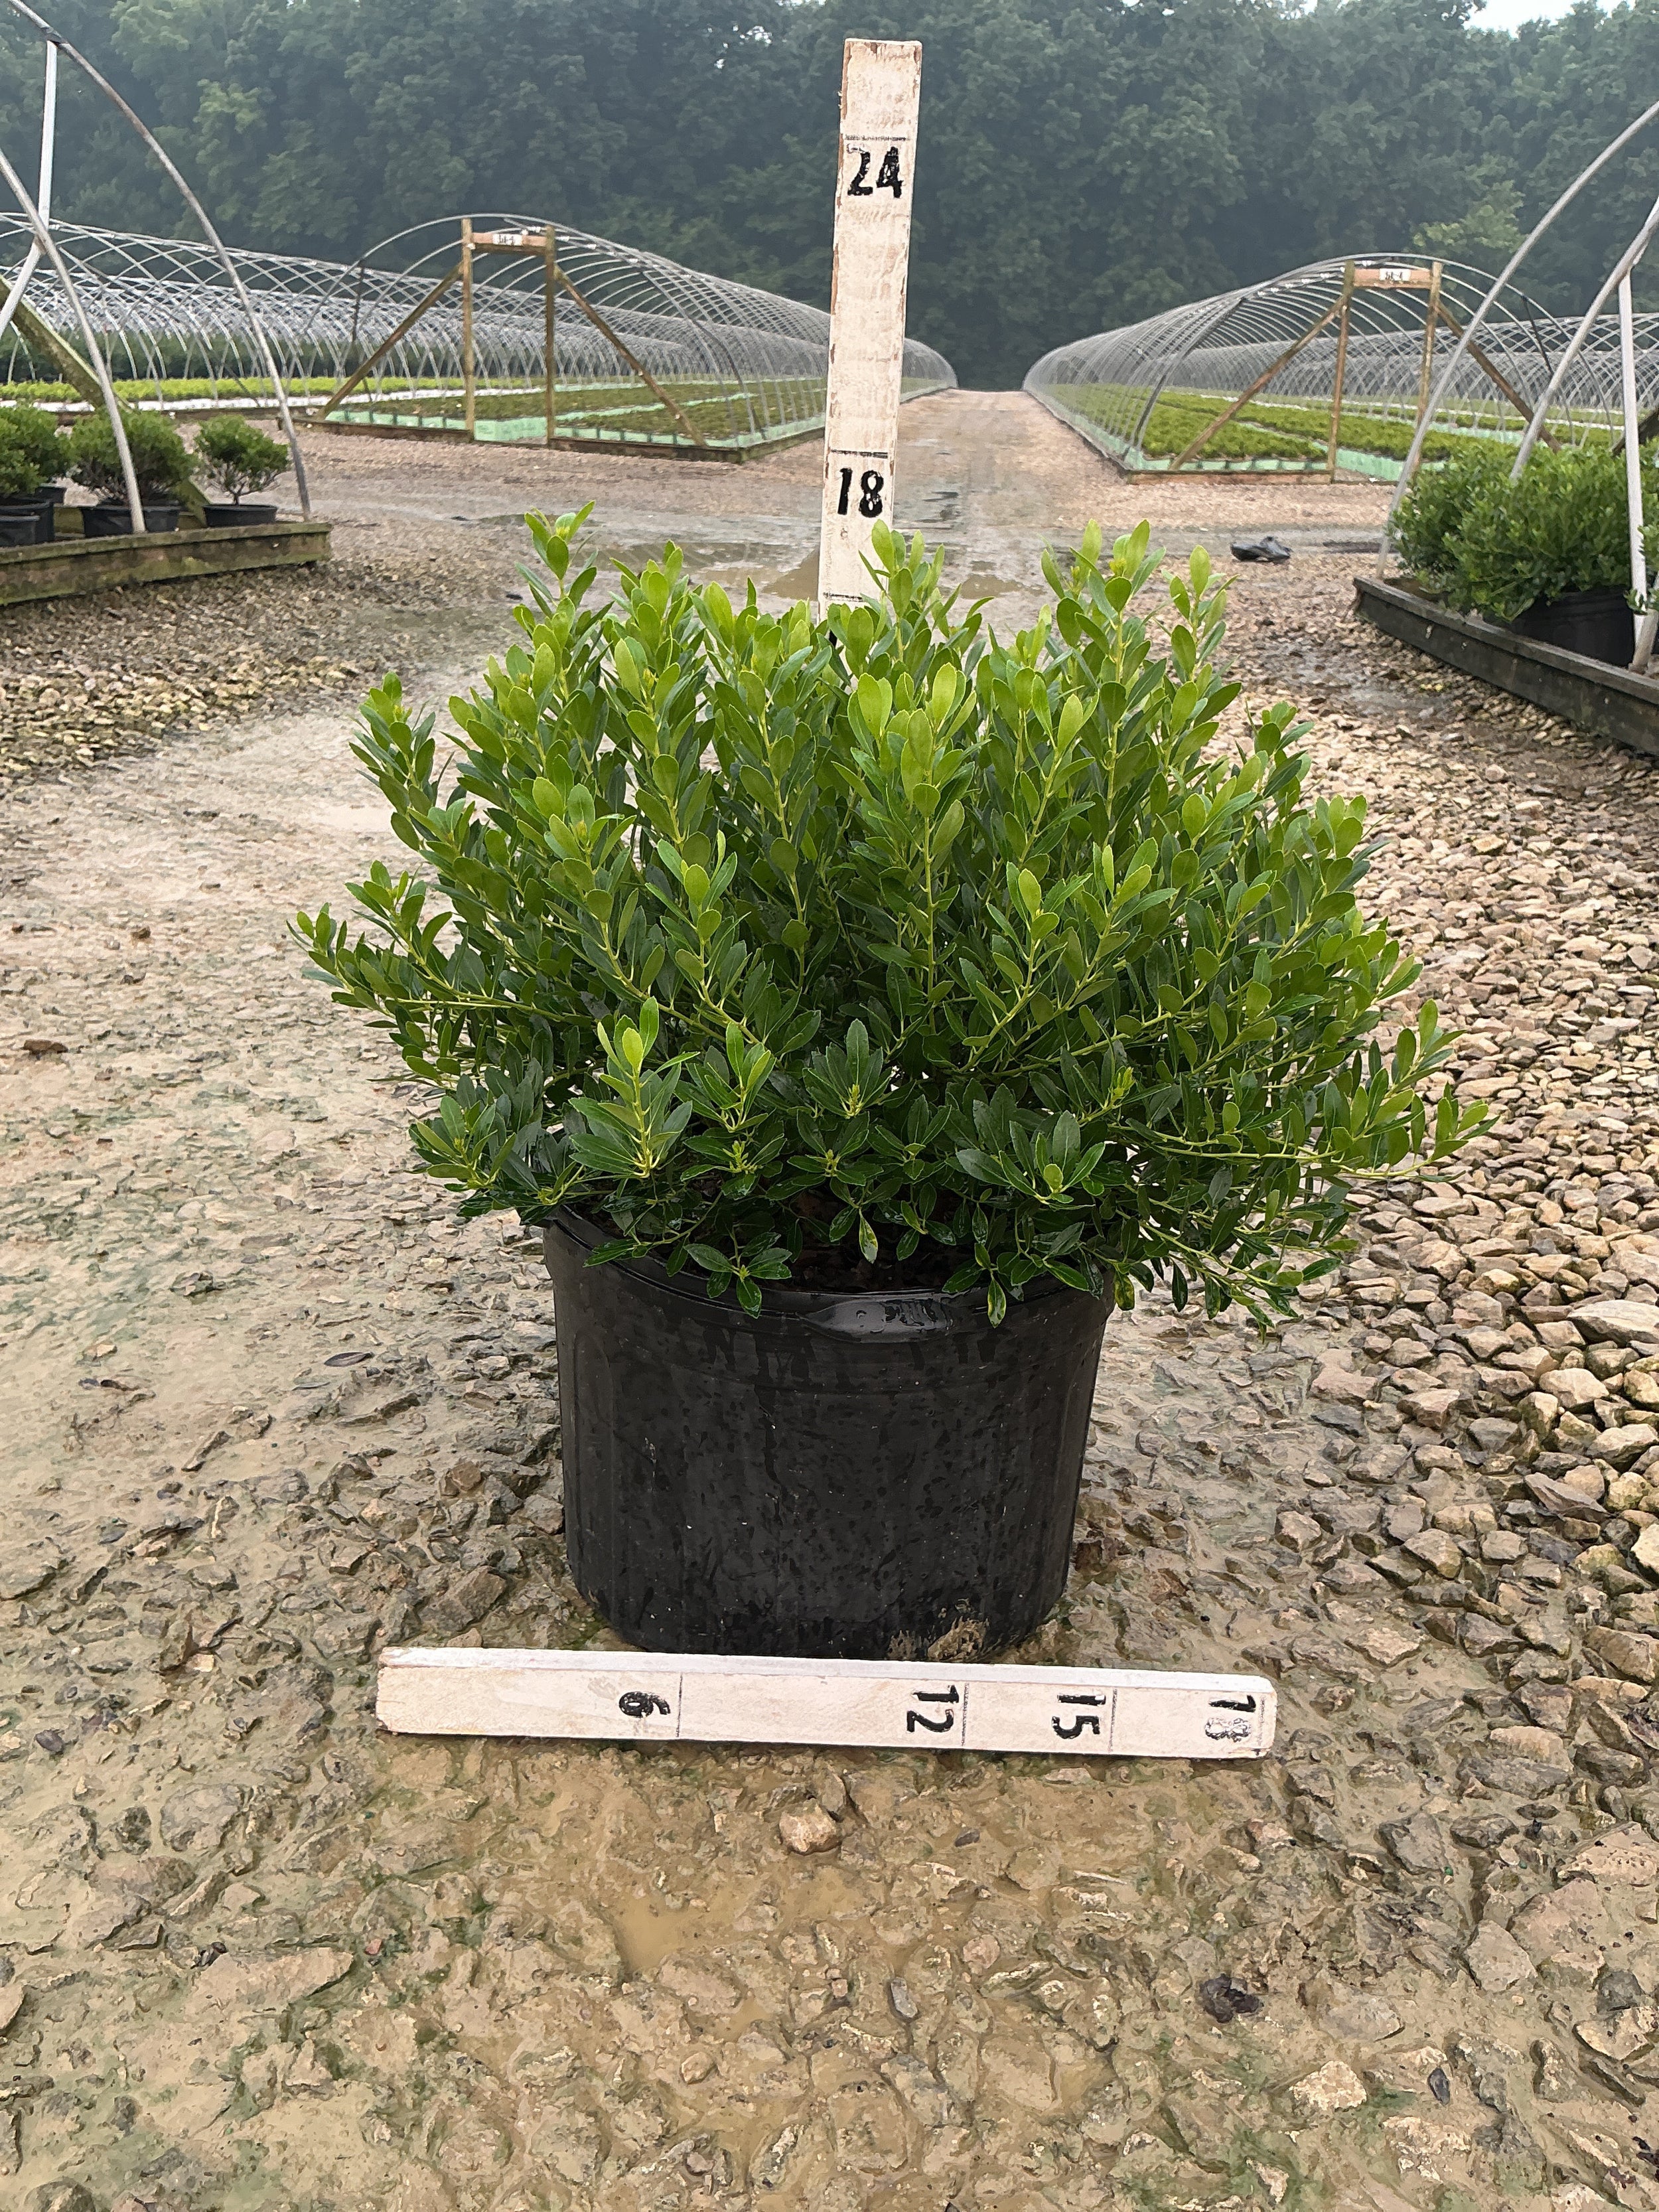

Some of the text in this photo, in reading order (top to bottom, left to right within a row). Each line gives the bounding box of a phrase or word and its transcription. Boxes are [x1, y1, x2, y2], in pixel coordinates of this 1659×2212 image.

[846, 143, 904, 198] 24
[837, 467, 885, 518] 18
[906, 1684, 960, 1734] 12
[1051, 1692, 1107, 1739] 15
[1204, 1694, 1256, 1743] 18
